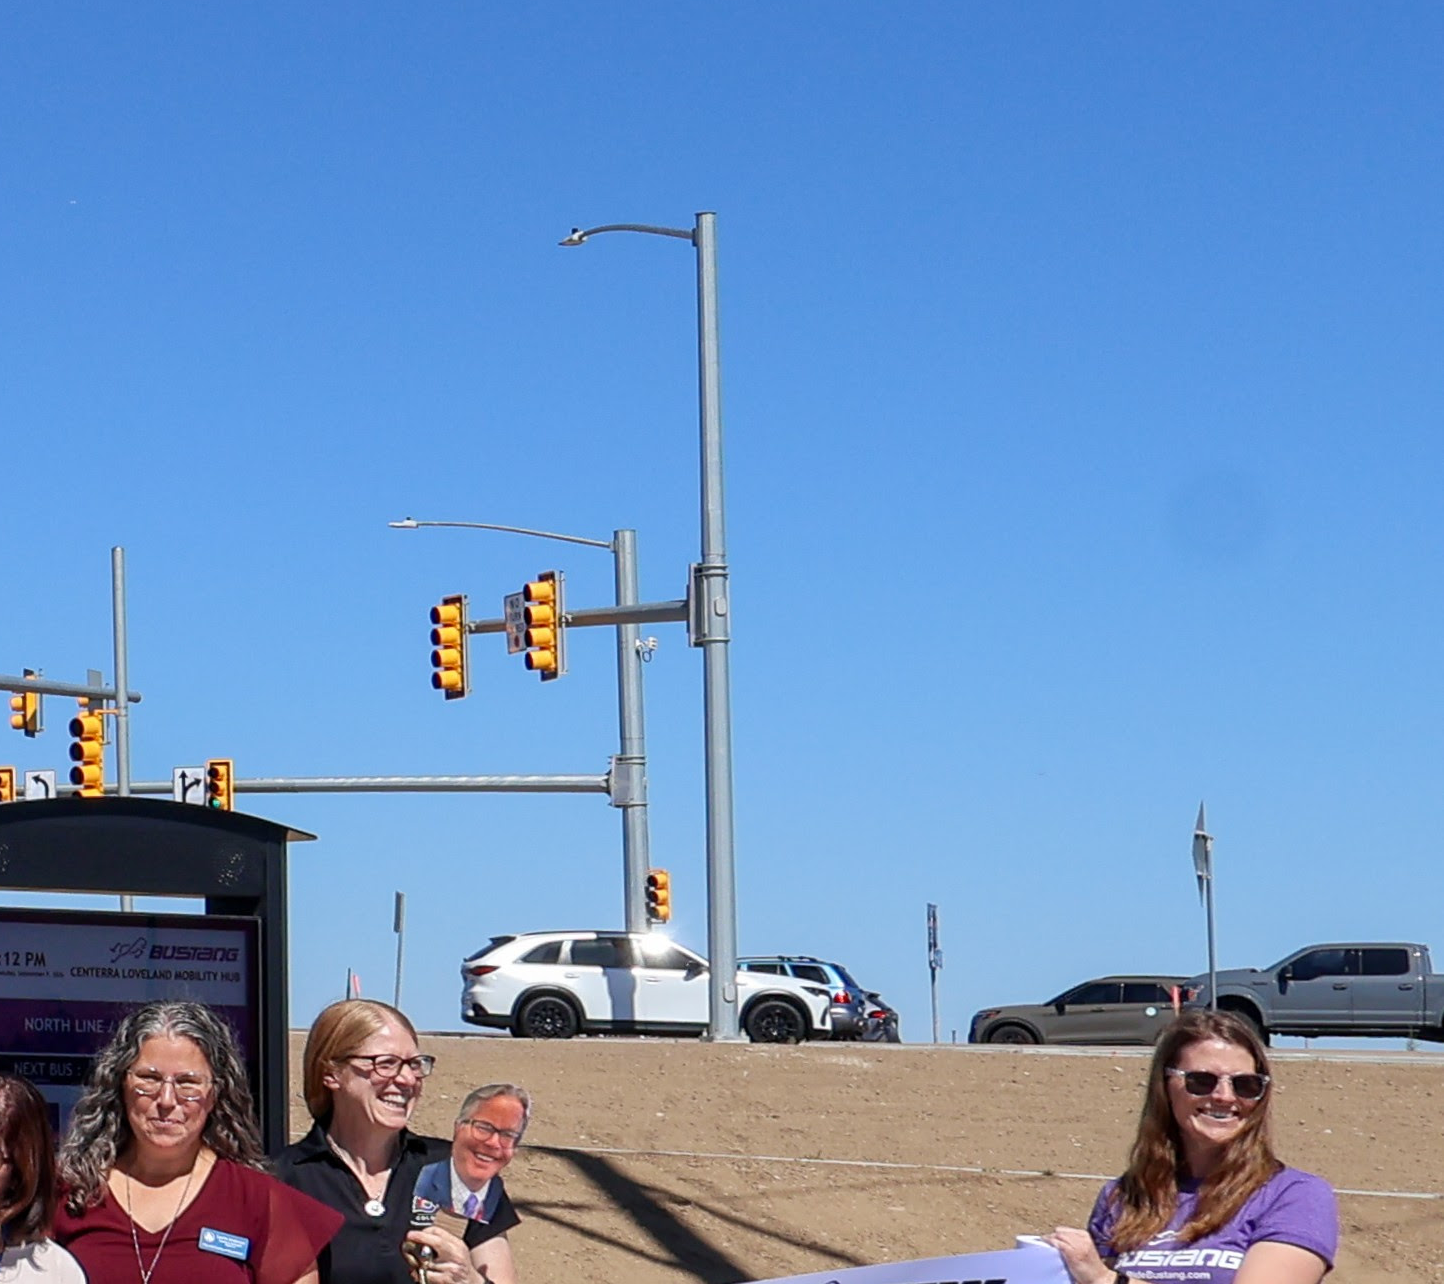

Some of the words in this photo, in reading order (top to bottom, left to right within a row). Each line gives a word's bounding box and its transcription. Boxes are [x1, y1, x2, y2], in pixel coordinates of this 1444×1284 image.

[25, 952, 46, 967] PM
[70, 967, 119, 980] CENTERRA
[122, 968, 172, 981] LOVELAND
[174, 970, 218, 982] MOBILITY
[220, 971, 241, 983] HUB
[24, 1018, 71, 1033] NORTH
[75, 1019, 104, 1034] LINE
[13, 1062, 46, 1077] NEXT
[49, 1062, 73, 1077] BUS
[1115, 1248, 1245, 1270] USTANG
